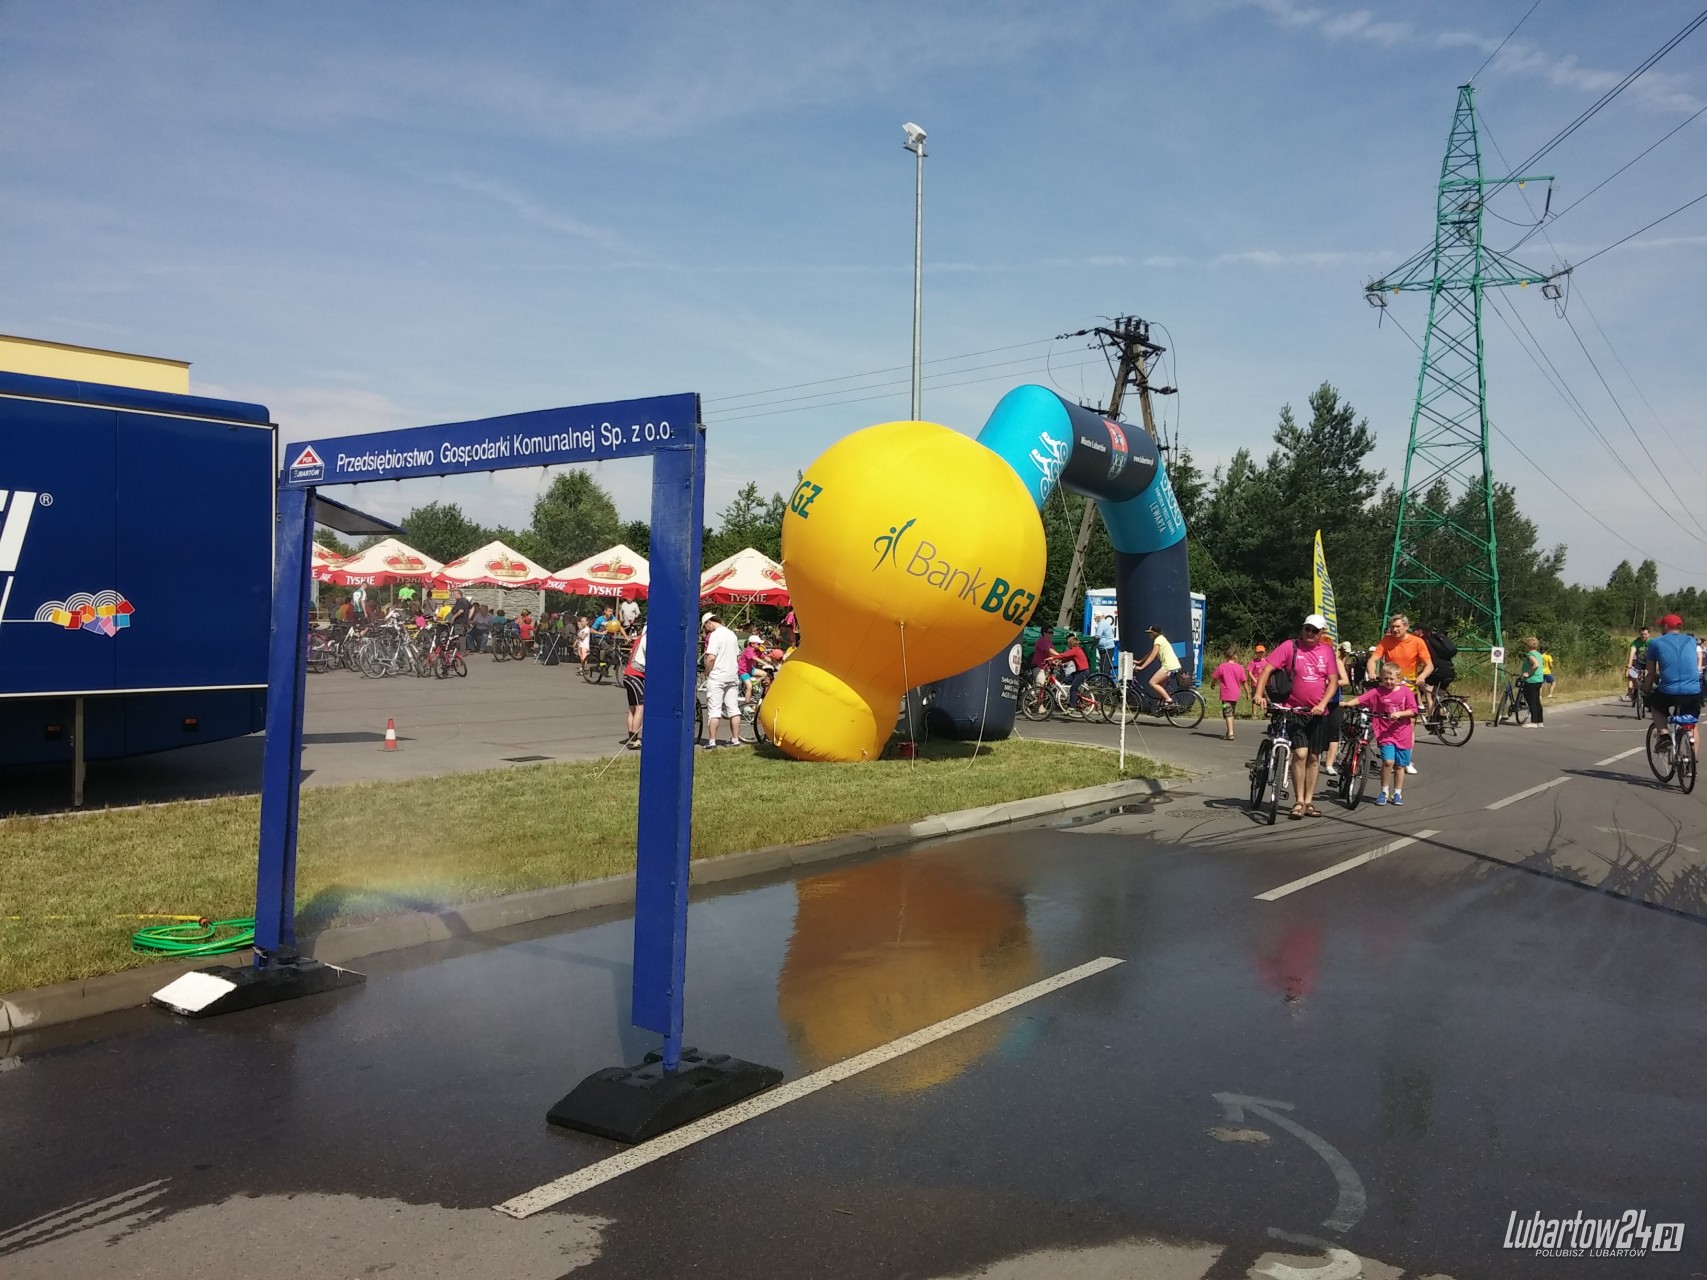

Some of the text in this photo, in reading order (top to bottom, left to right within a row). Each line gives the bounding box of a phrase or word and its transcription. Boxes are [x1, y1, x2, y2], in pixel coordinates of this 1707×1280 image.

[336, 447, 433, 474] Przedsiębiorstwo
[440, 435, 510, 467] Gospodarki
[514, 425, 595, 454] Komunalnej
[601, 422, 626, 450] Sp.
[1149, 501, 1167, 534] LEWARTA
[346, 575, 375, 585] TYSKIE
[906, 540, 987, 605] Bank
[588, 584, 624, 597] TYSKIE
[729, 592, 767, 603] TYSKIE
